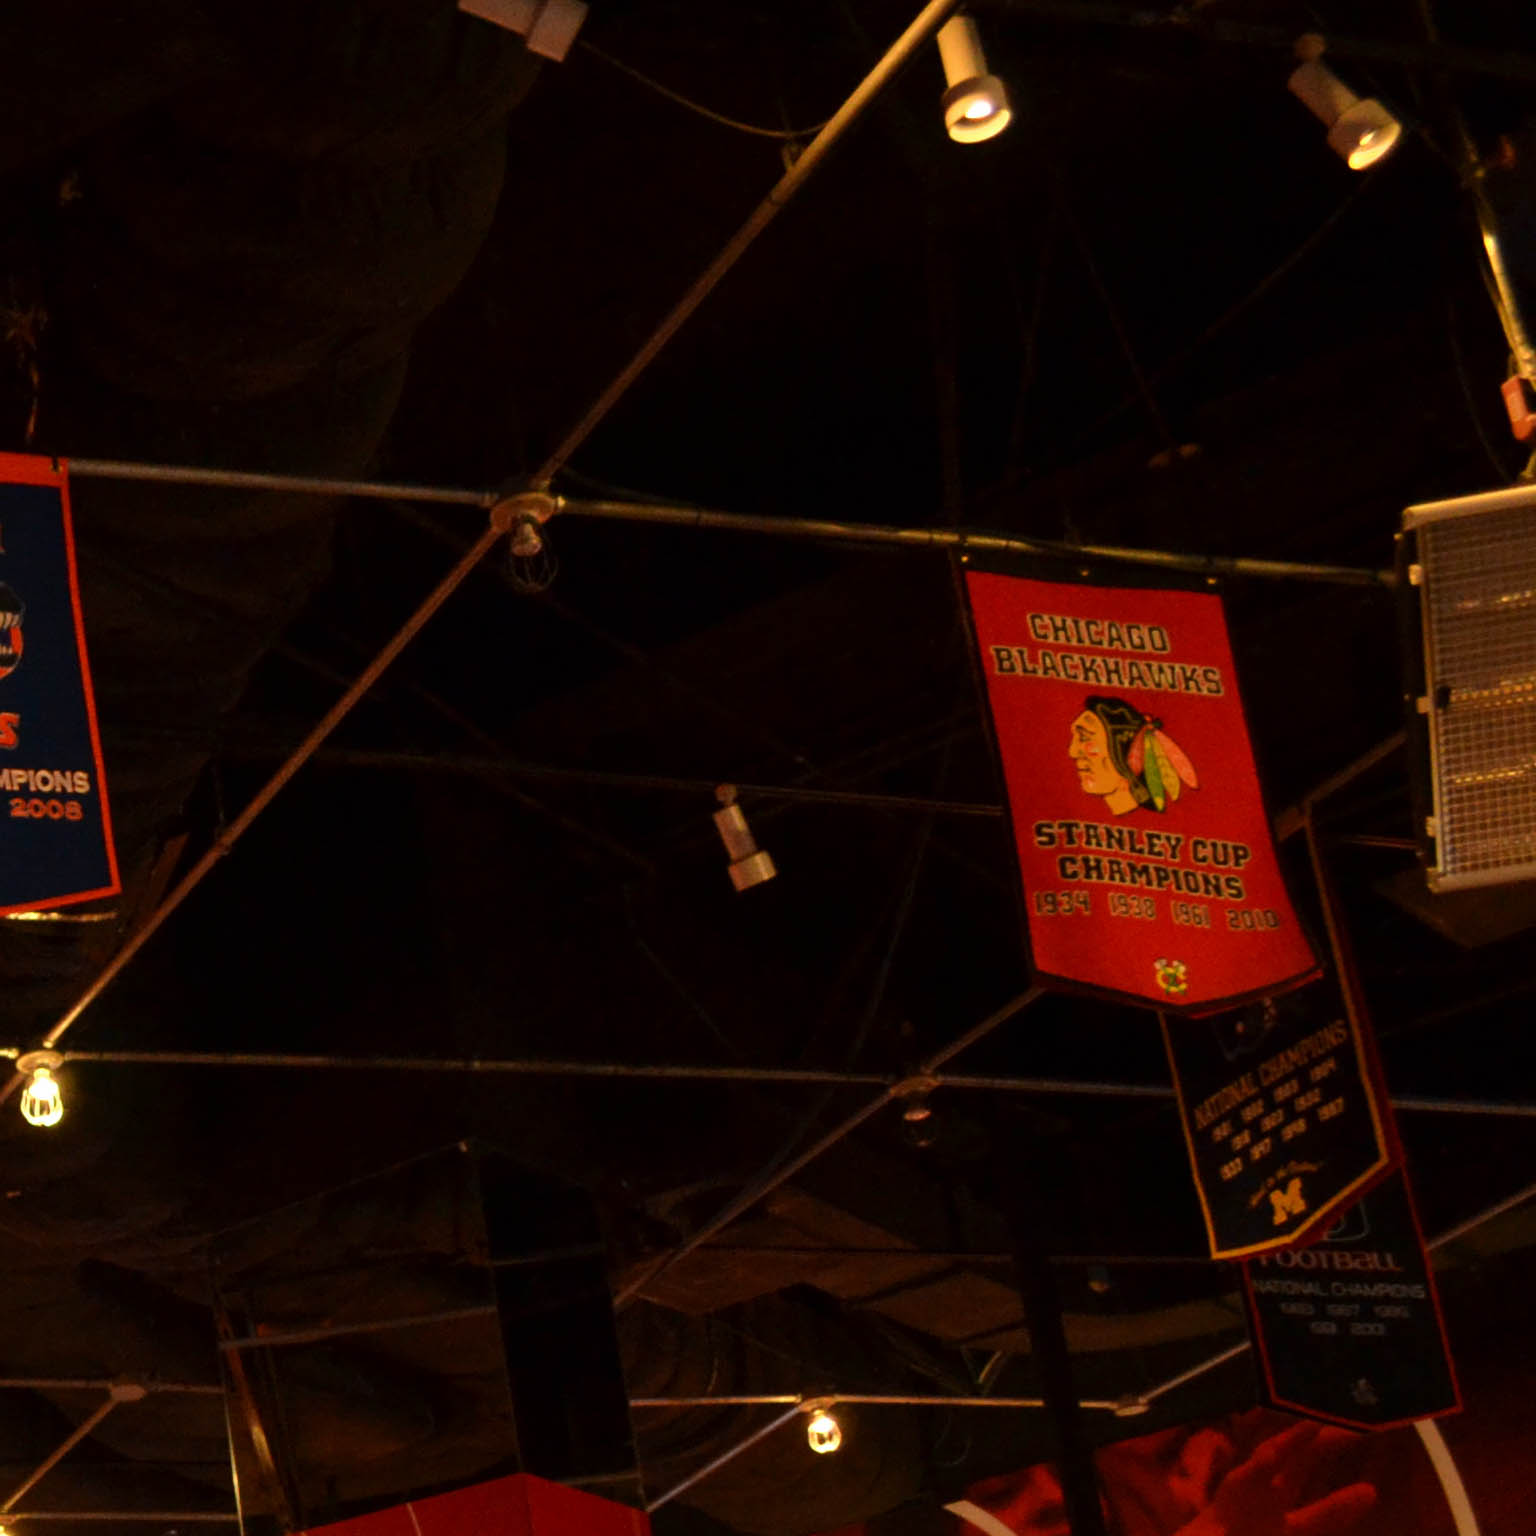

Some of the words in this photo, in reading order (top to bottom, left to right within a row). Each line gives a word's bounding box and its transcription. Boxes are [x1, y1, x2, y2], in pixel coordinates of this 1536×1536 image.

[1028, 612, 1170, 654] CHICAGO
[991, 645, 1225, 696] BLACKHAWKS
[10, 798, 82, 820] 2008
[1033, 820, 1182, 861] STANLEY
[1191, 838, 1251, 869] CUP
[1057, 856, 1245, 900] CHAMPIONS
[1035, 891, 1091, 916] 1934
[1171, 901, 1211, 928] 1961
[1228, 909, 1280, 931] 2010
[1253, 1280, 1328, 1297] NATIONAL
[1330, 1281, 1427, 1299] CHAMPIONS
